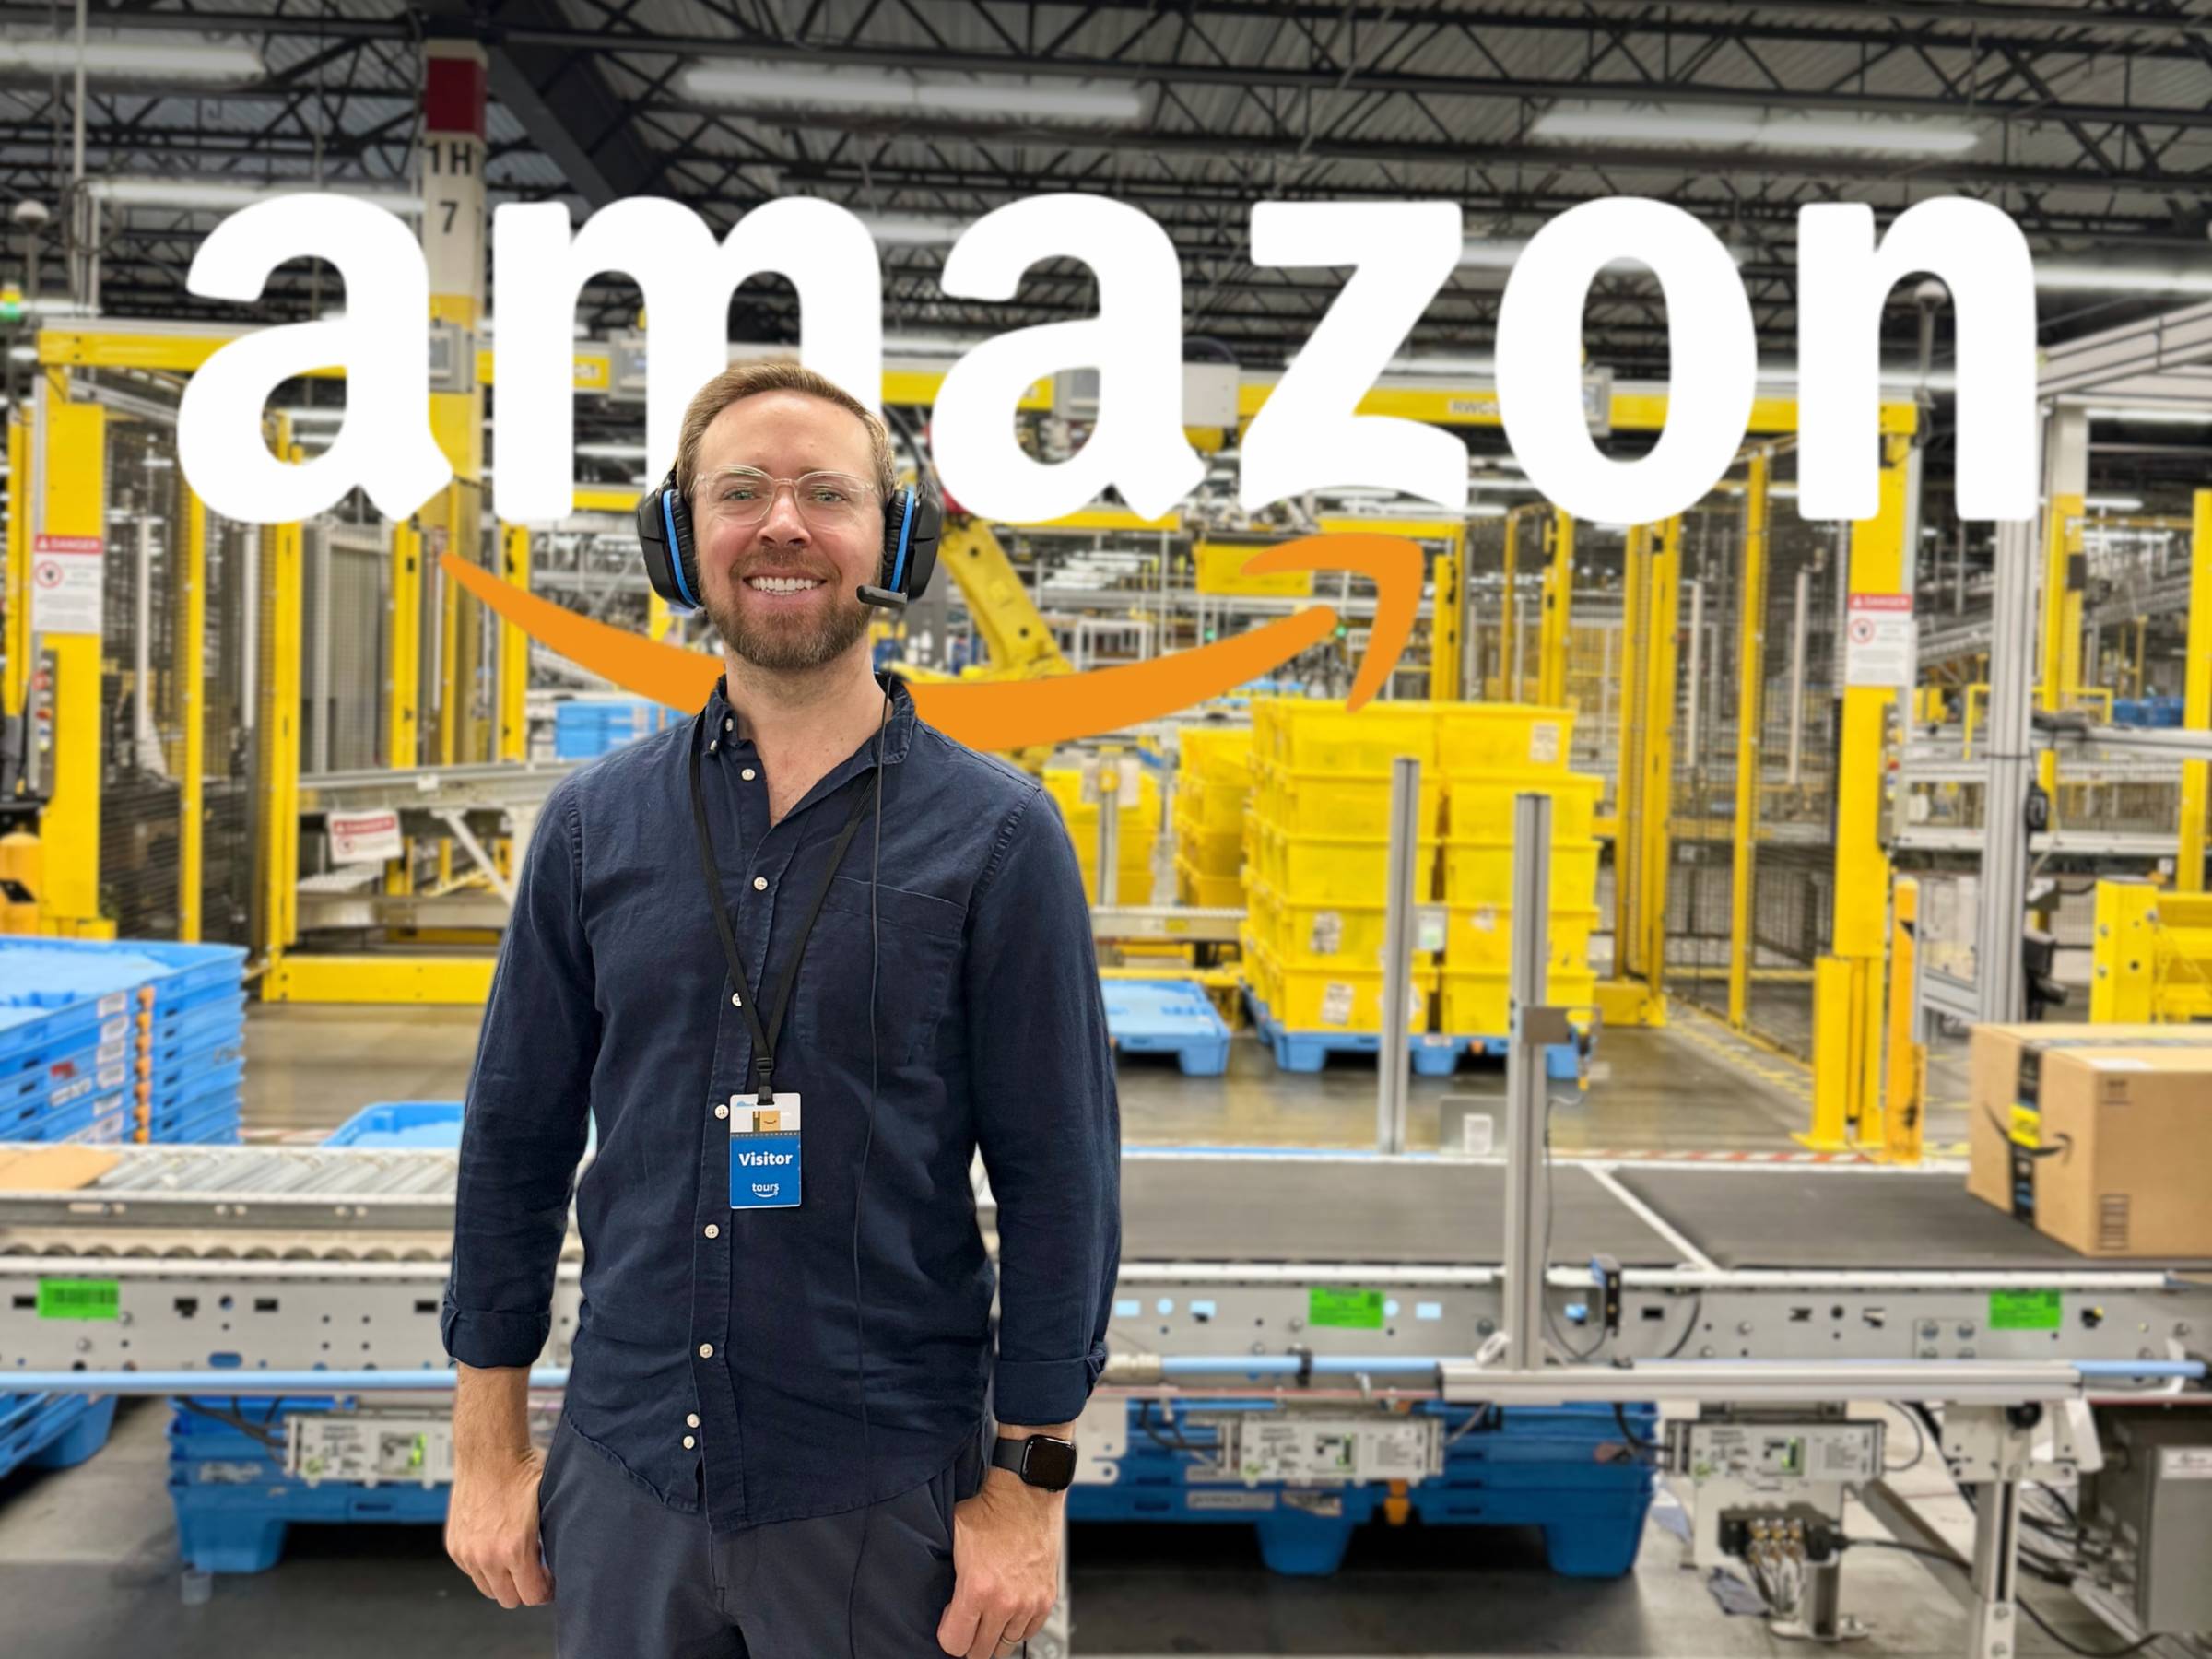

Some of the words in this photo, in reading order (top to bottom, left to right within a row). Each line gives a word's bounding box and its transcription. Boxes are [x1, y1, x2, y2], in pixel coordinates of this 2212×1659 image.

[428, 140, 471, 176] 1H
[439, 199, 459, 235] 7
[51, 538, 100, 551] DANGER
[738, 1150, 794, 1167] Visitor
[751, 1182, 780, 1193] tours
